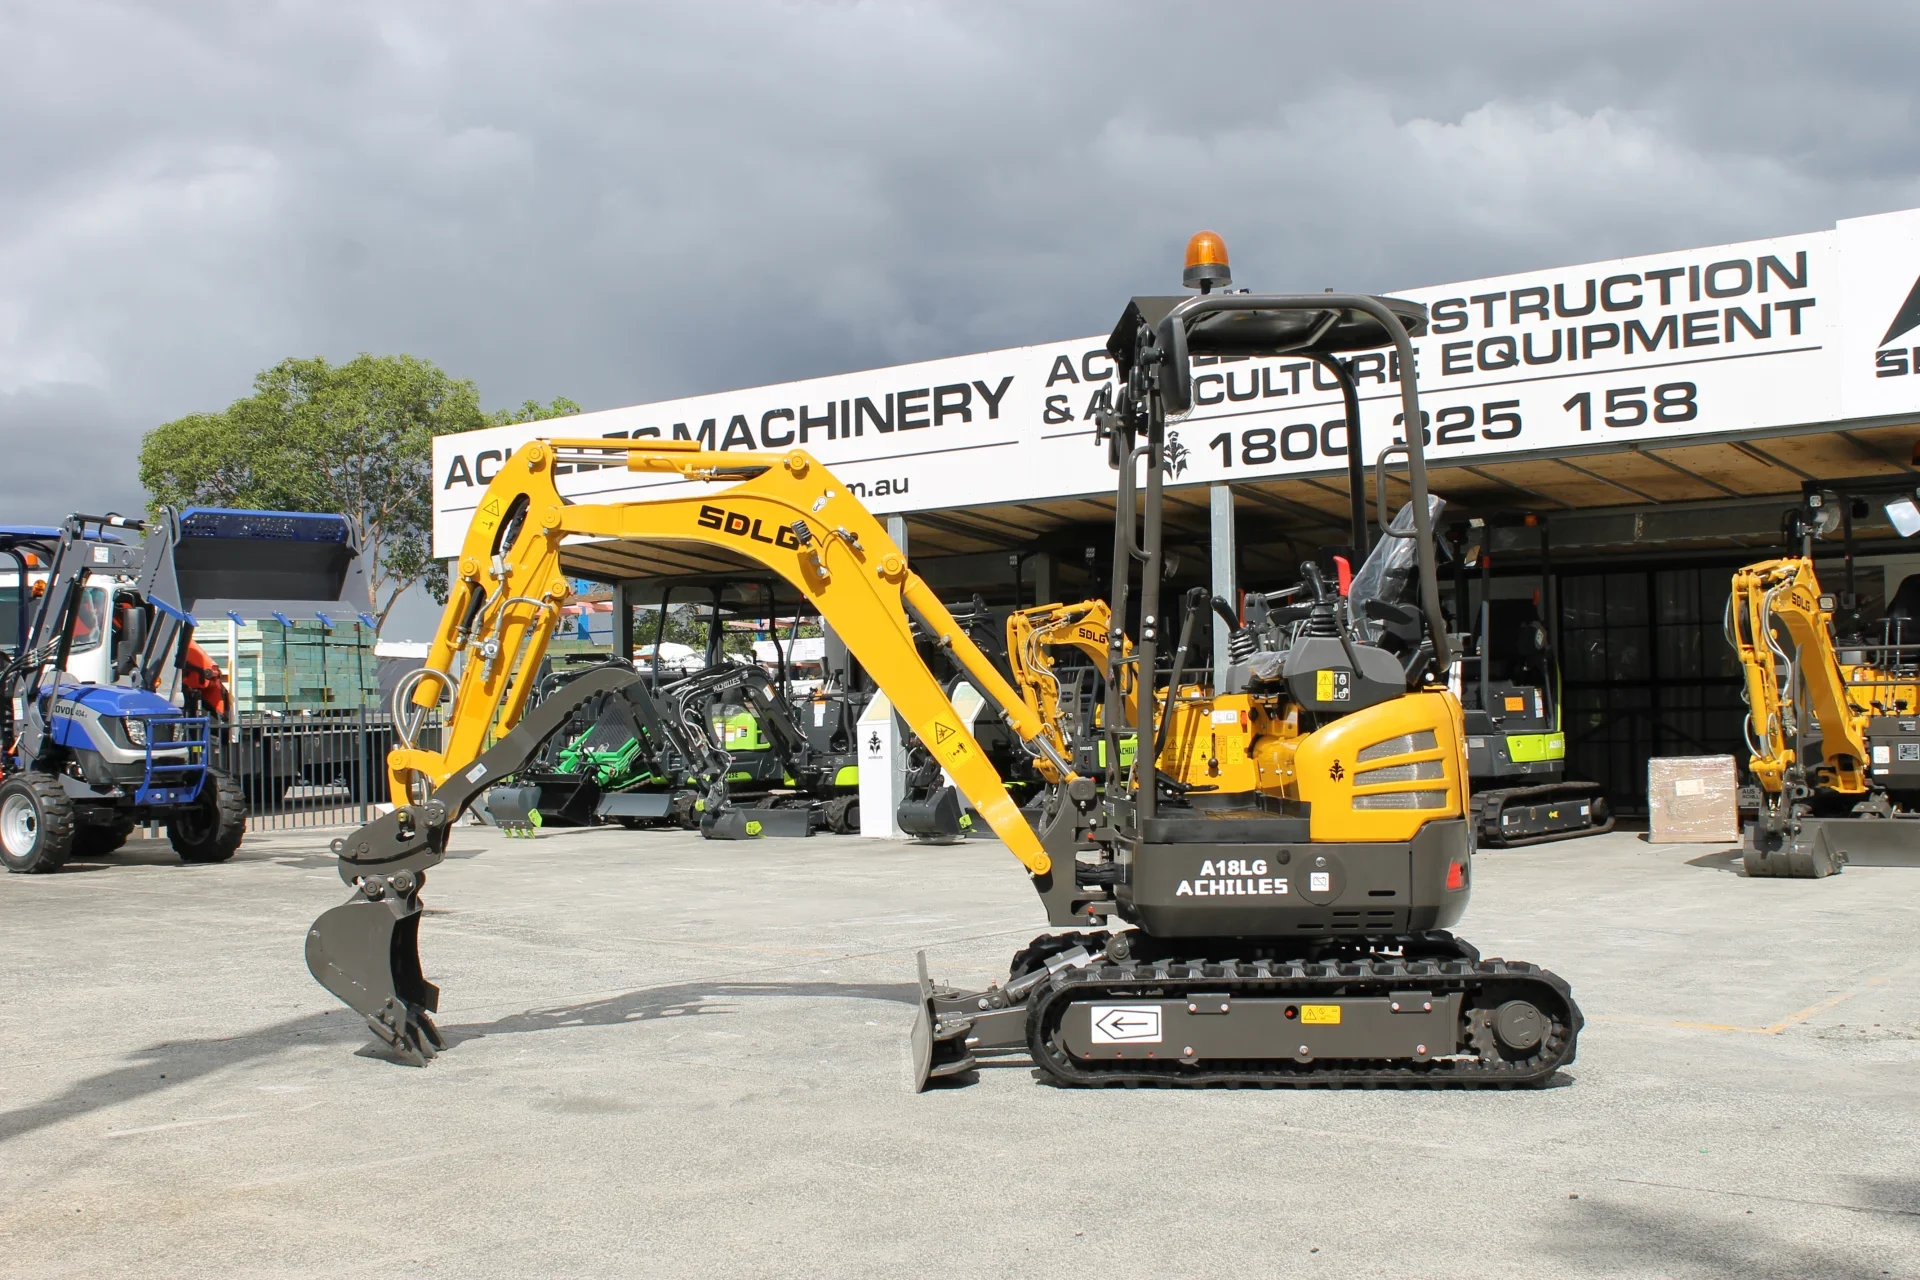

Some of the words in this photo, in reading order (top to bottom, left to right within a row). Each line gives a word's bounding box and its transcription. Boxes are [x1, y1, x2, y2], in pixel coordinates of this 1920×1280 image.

[1410, 251, 1807, 337] STRUCTION
[1043, 394, 1074, 425] &
[1084, 347, 1420, 421] ACULTURE
[1441, 297, 1816, 377] EQUIPMENT
[1875, 346, 1920, 379] S
[672, 376, 1014, 453] MACHINERY
[1208, 418, 1348, 468] 1800
[1392, 398, 1522, 448] 325
[1562, 381, 1698, 431] 158
[697, 504, 801, 551] SDLG
[1792, 592, 1811, 613] SDLG
[1078, 627, 1106, 644] SDLG
[53, 705, 74, 716] OVOL
[1200, 858, 1268, 877] A18LG
[1176, 877, 1288, 896] ACHILLES
